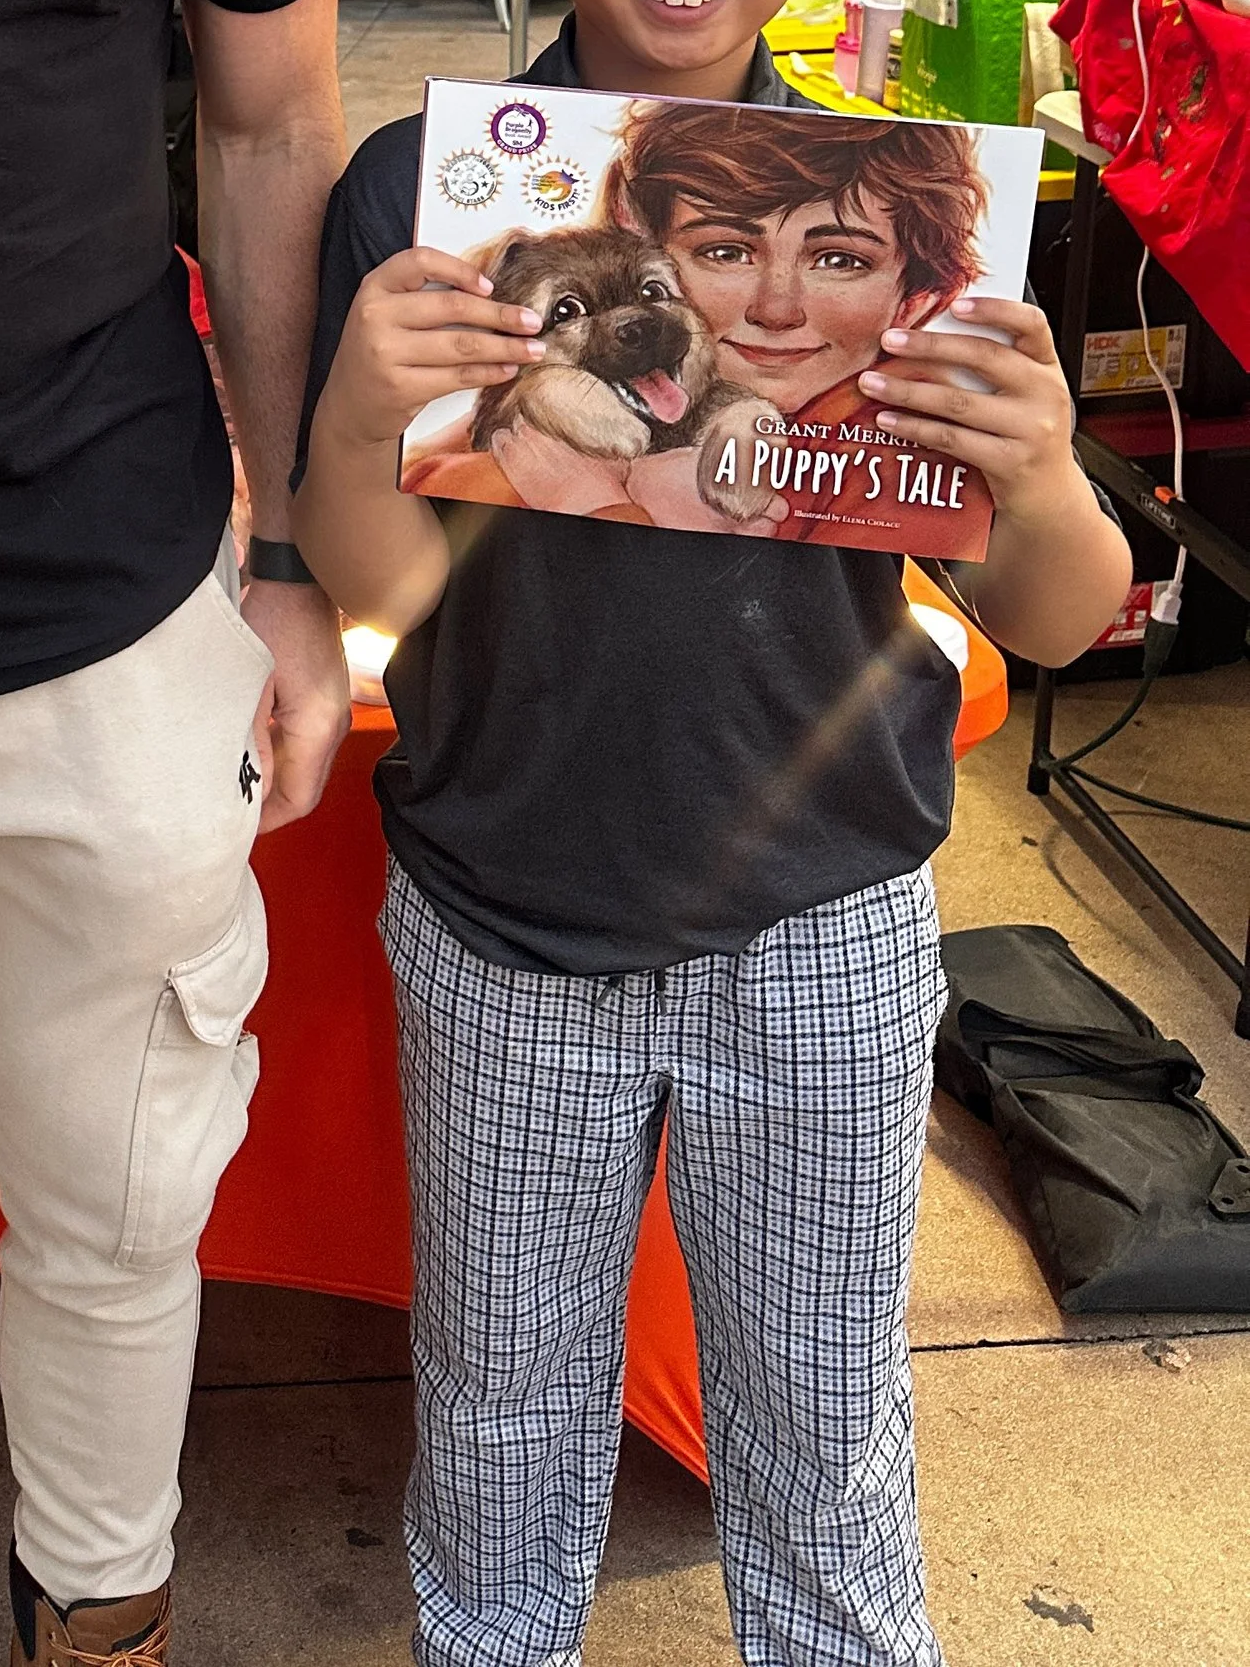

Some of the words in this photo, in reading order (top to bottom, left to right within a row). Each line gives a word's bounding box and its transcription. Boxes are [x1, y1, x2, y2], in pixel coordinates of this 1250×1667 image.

[534, 197, 555, 211] KIDS
[755, 416, 833, 440] GRANT
[837, 423, 920, 448] MERR
[714, 437, 737, 485] A
[751, 437, 883, 500] PUPPY'S
[896, 454, 968, 509] TALE
[793, 509, 831, 521] Illustrated
[831, 513, 841, 523] by
